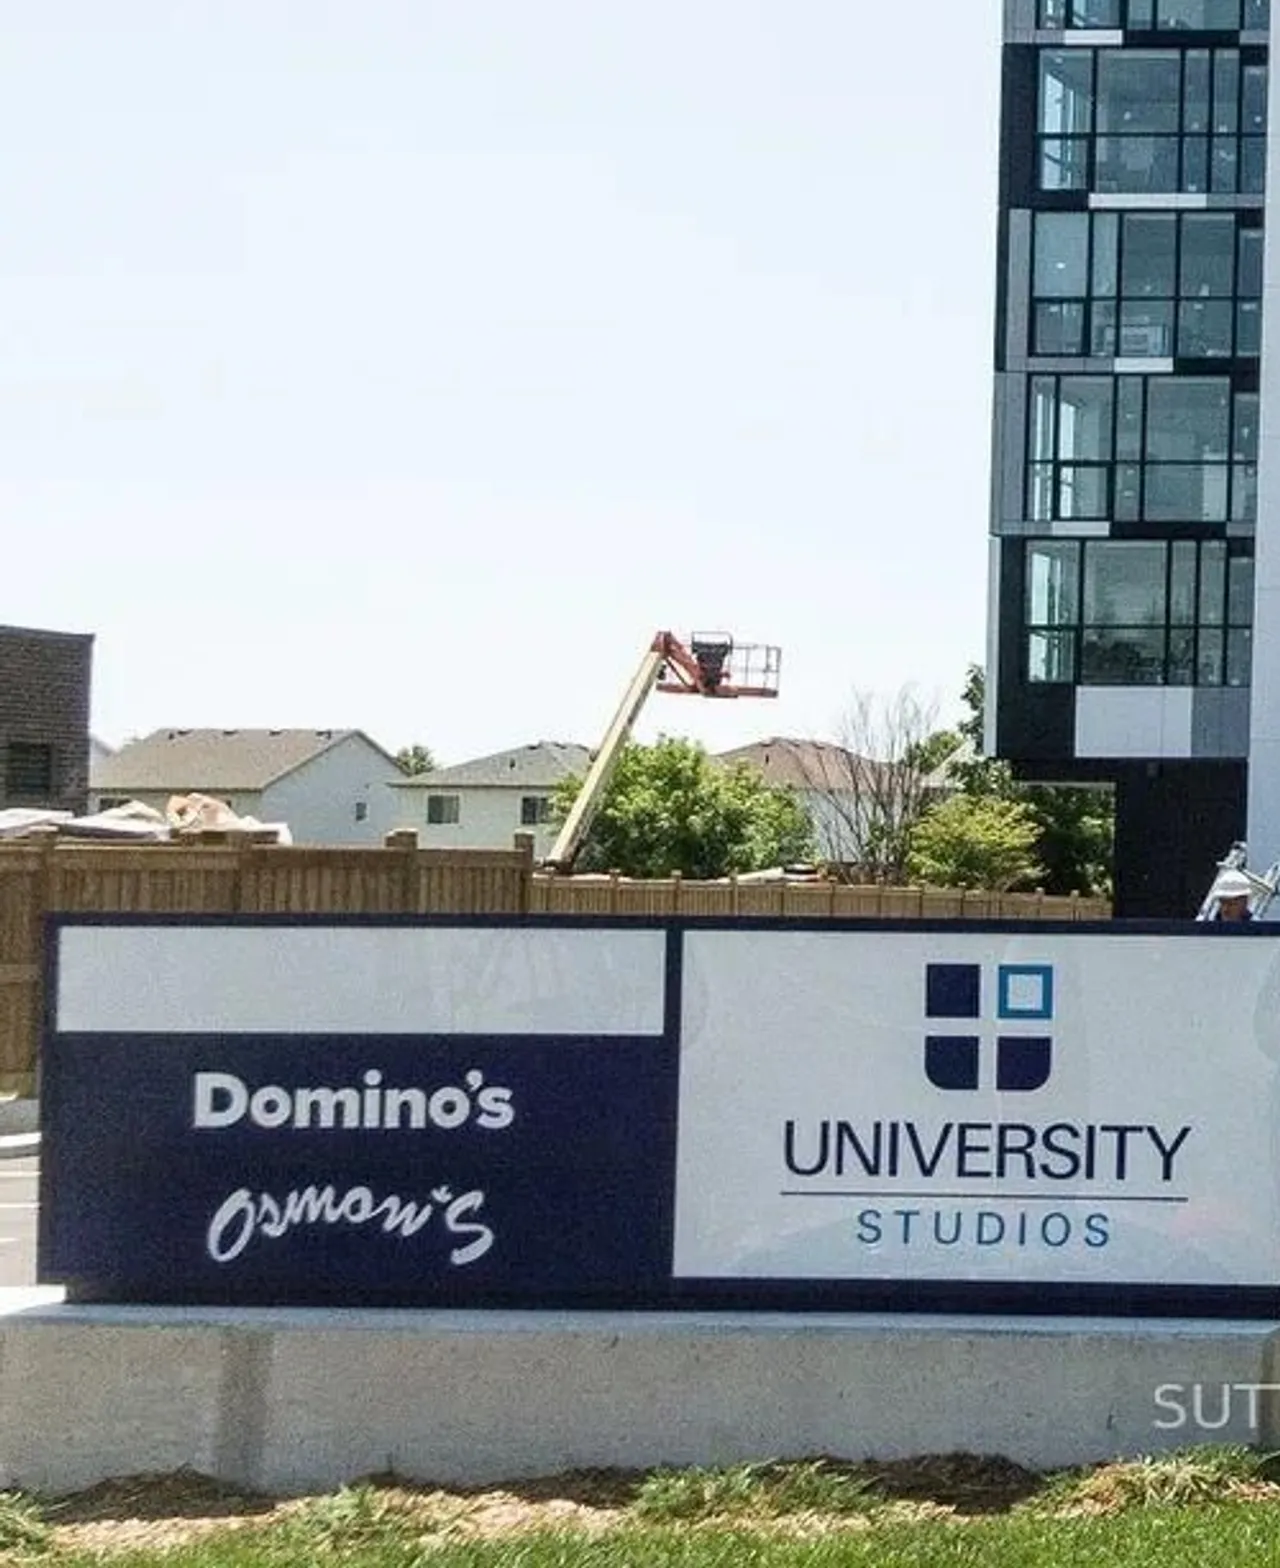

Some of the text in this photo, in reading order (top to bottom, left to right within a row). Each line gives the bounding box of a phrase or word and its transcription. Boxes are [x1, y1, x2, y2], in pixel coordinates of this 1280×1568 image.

[193, 1069, 515, 1129] Domino's
[785, 1120, 1192, 1181] UNIVERSITY
[857, 1208, 1111, 1247] STUDIOS
